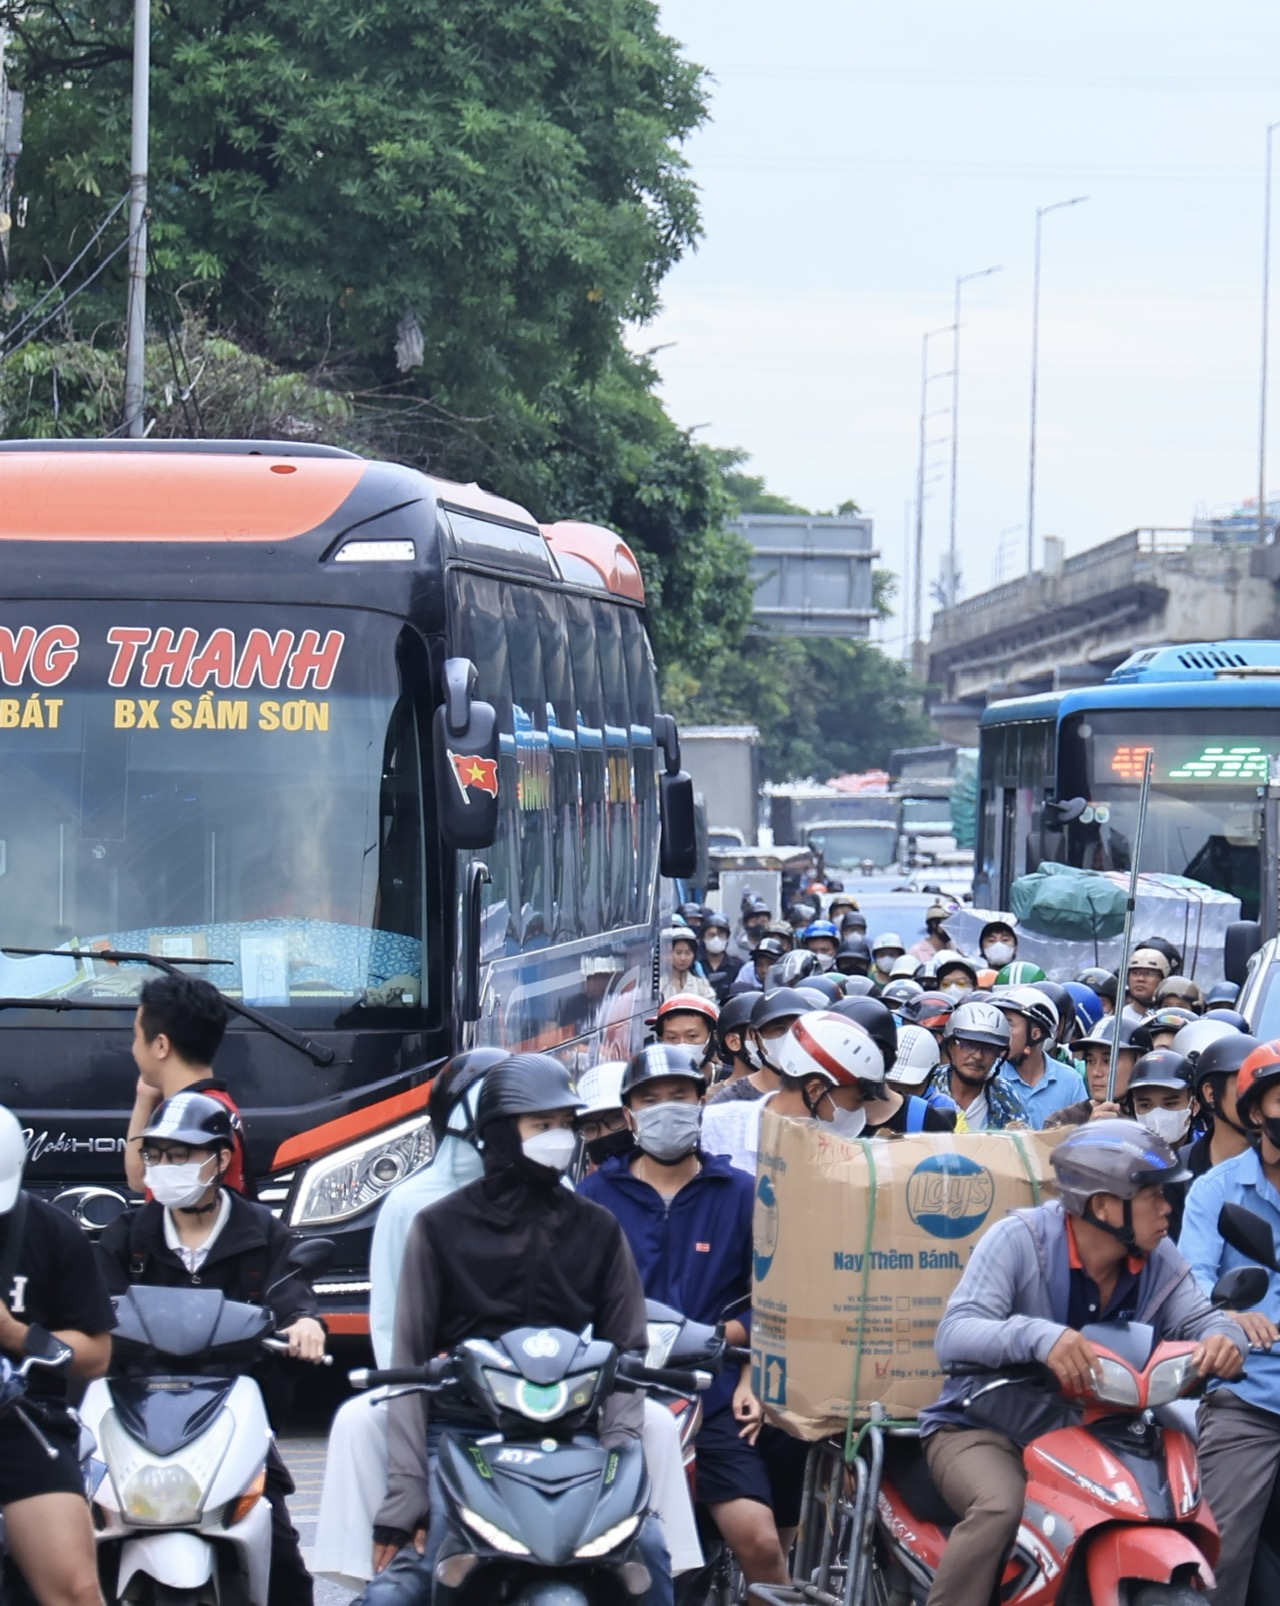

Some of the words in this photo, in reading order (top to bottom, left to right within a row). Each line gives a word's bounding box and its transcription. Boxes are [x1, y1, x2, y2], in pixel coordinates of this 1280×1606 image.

[107, 626, 345, 689] THANH
[0, 693, 63, 729] BÁT
[114, 699, 160, 729] BX
[170, 690, 248, 730] SẦM
[258, 699, 330, 731] SƠN
[913, 1173, 988, 1217] Lay's
[834, 1252, 864, 1272] Nay
[869, 1248, 913, 1270] Thêm
[919, 1248, 963, 1271] Bánh,
